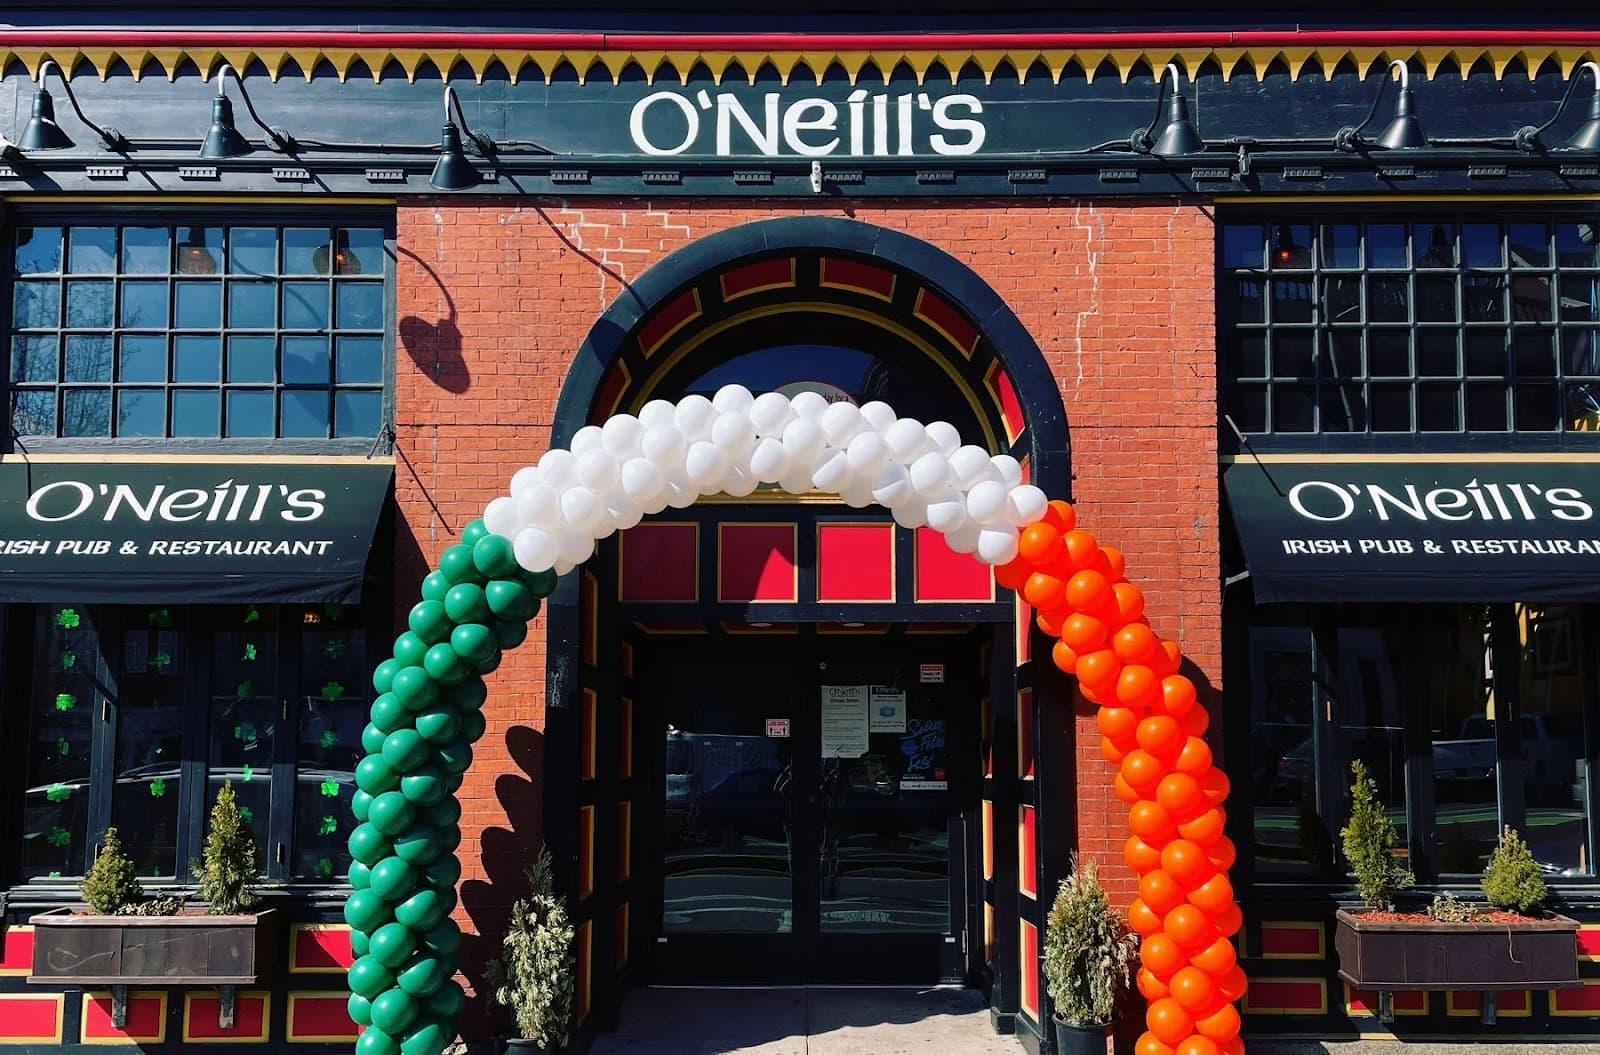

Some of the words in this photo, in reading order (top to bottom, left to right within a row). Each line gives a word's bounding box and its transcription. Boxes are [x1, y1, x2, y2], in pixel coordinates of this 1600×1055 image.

[629, 89, 986, 156] O'Neill's
[25, 478, 326, 522] O'Neill's
[1288, 478, 1593, 521] O'Neill's
[0, 540, 51, 555] RISH
[55, 540, 112, 555] PUB
[119, 540, 138, 555] &
[149, 540, 334, 555] RESTAURANT
[1282, 539, 1353, 554] IRISH
[1359, 539, 1414, 554] PUB
[1423, 539, 1444, 554] &
[1452, 539, 1600, 554] RESTAURAN
